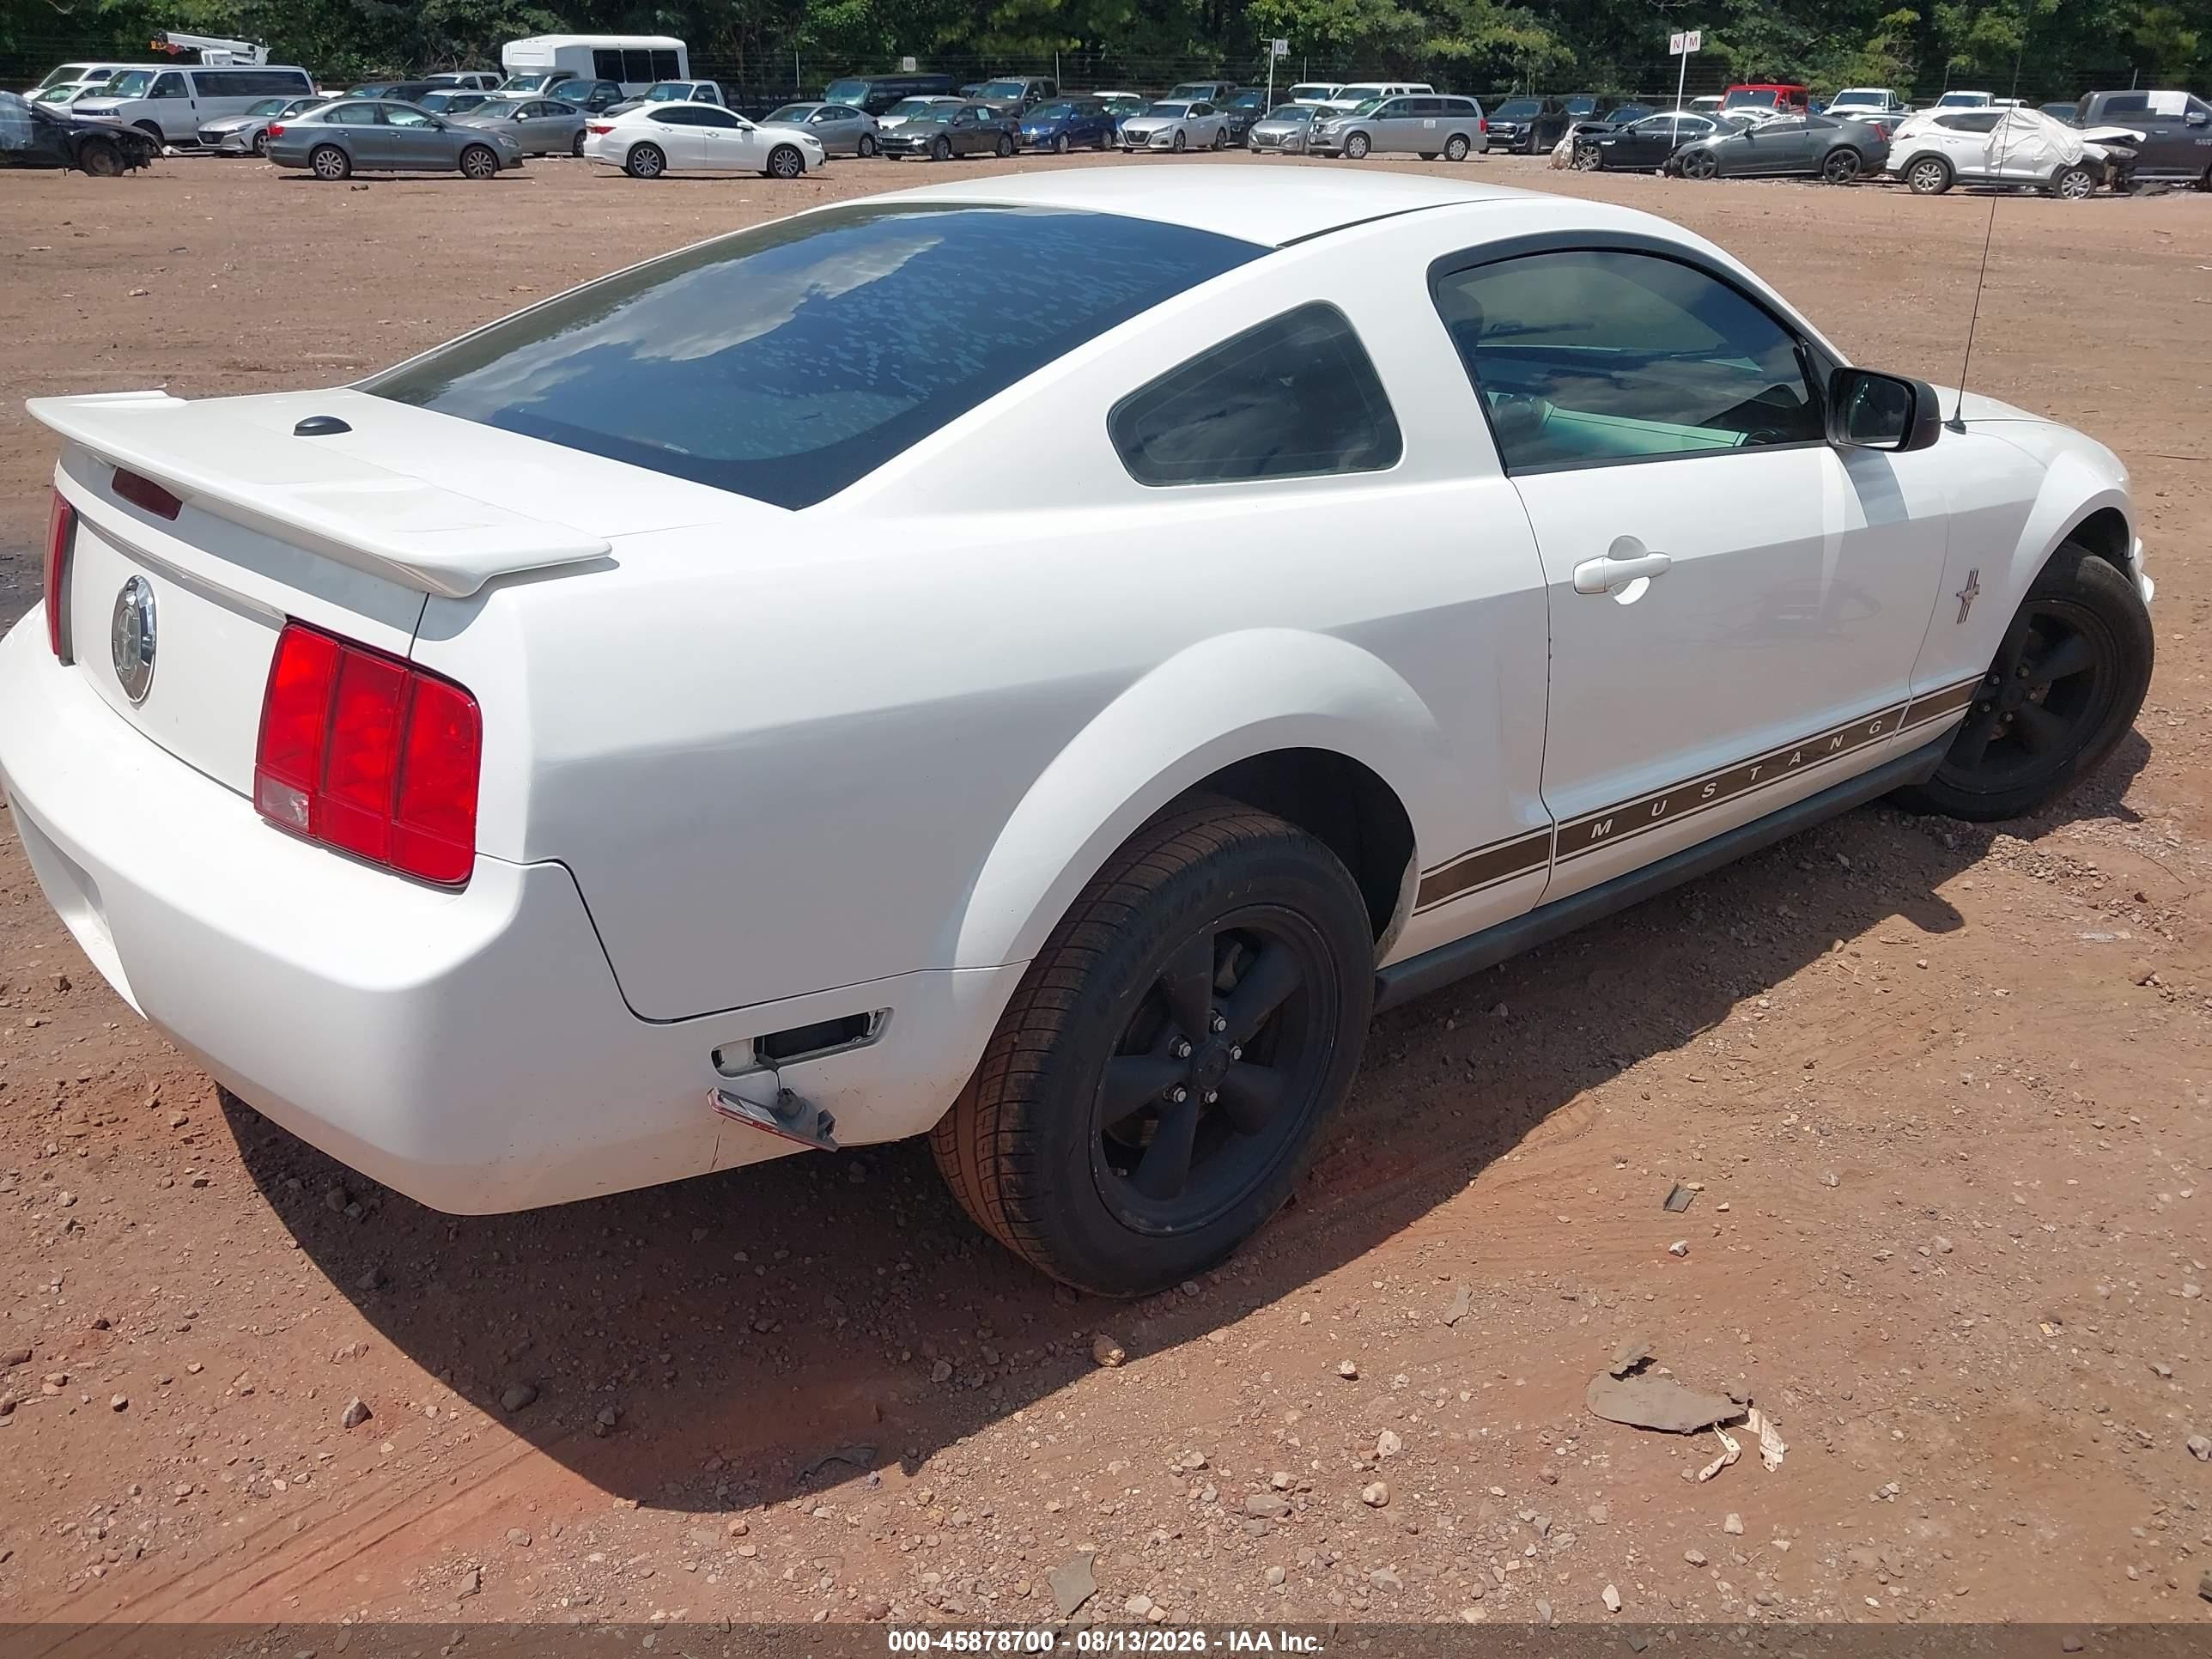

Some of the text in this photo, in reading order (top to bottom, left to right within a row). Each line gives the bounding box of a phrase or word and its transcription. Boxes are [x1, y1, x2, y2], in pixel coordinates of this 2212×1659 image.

[1674, 39, 1680, 50] N
[1689, 36, 1698, 48] M
[1590, 720, 1882, 839] MUSTANG
